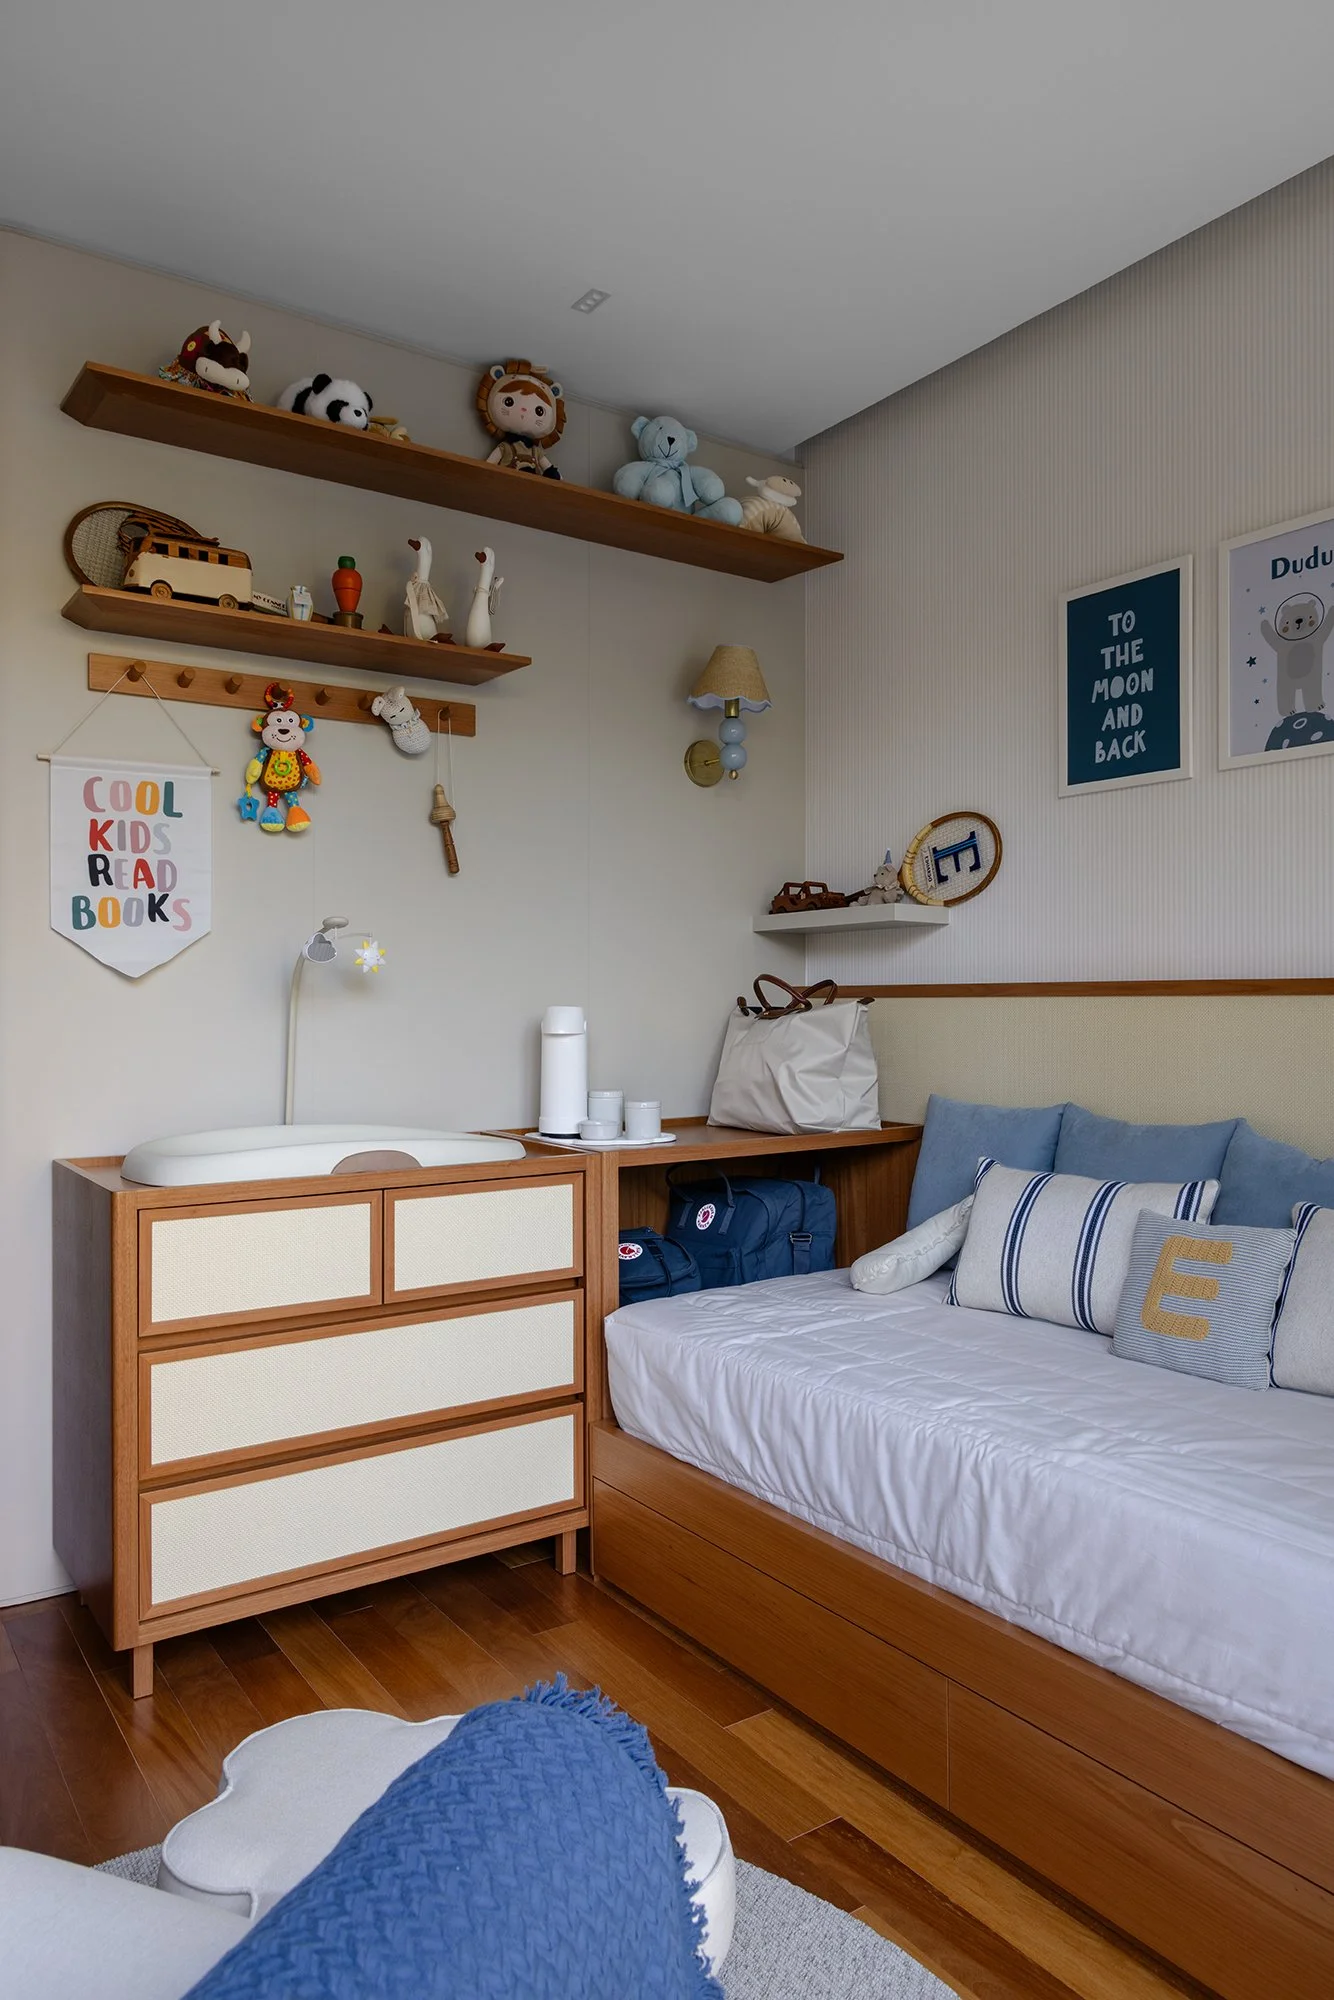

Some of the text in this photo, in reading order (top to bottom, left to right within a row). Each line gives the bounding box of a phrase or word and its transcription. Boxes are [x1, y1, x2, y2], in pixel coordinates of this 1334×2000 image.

[1271, 545, 1333, 580] Dudu
[1107, 609, 1136, 637] TO
[1101, 638, 1144, 670] THE
[1091, 667, 1154, 704] MOON
[1101, 703, 1143, 732] AND
[1095, 729, 1147, 764] BACK
[83, 776, 183, 818] COOL
[88, 818, 172, 855] KIDS
[87, 853, 178, 893] READ
[932, 830, 982, 884] E
[71, 892, 193, 932] BOOKS
[1140, 1234, 1233, 1342] E
